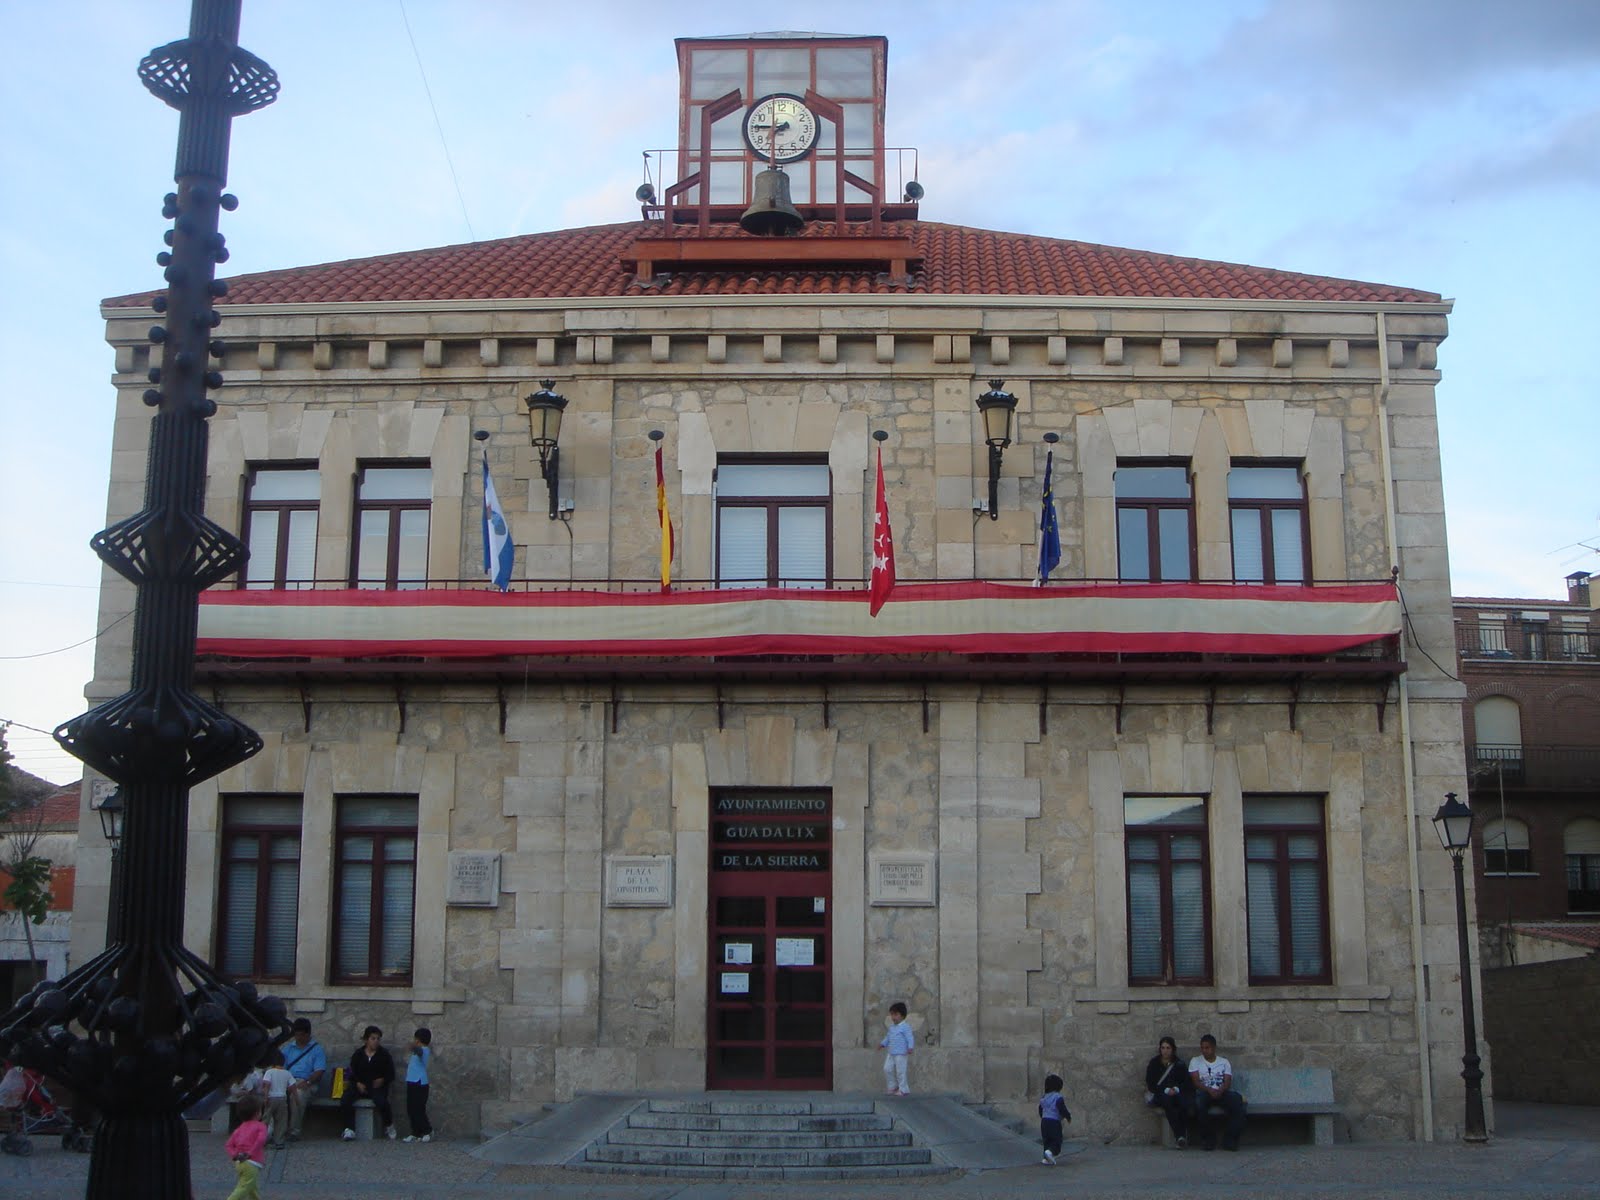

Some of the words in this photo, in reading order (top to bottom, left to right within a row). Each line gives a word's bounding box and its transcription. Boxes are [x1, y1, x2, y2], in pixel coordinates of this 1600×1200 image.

[778, 104, 786, 112] 12
[758, 114, 766, 122] 10
[800, 114, 805, 122] 2
[803, 125, 809, 134] 3
[758, 136, 763, 144] 8
[779, 146, 784, 154] 6
[791, 143, 796, 151] 5
[718, 799, 826, 810] AYUNTAMIENTO
[726, 827, 815, 838] GUADALIX
[722, 855, 740, 866] DE
[745, 855, 763, 866] LA
[767, 855, 819, 866] SIERRA
[625, 868, 652, 876] PLAZA
